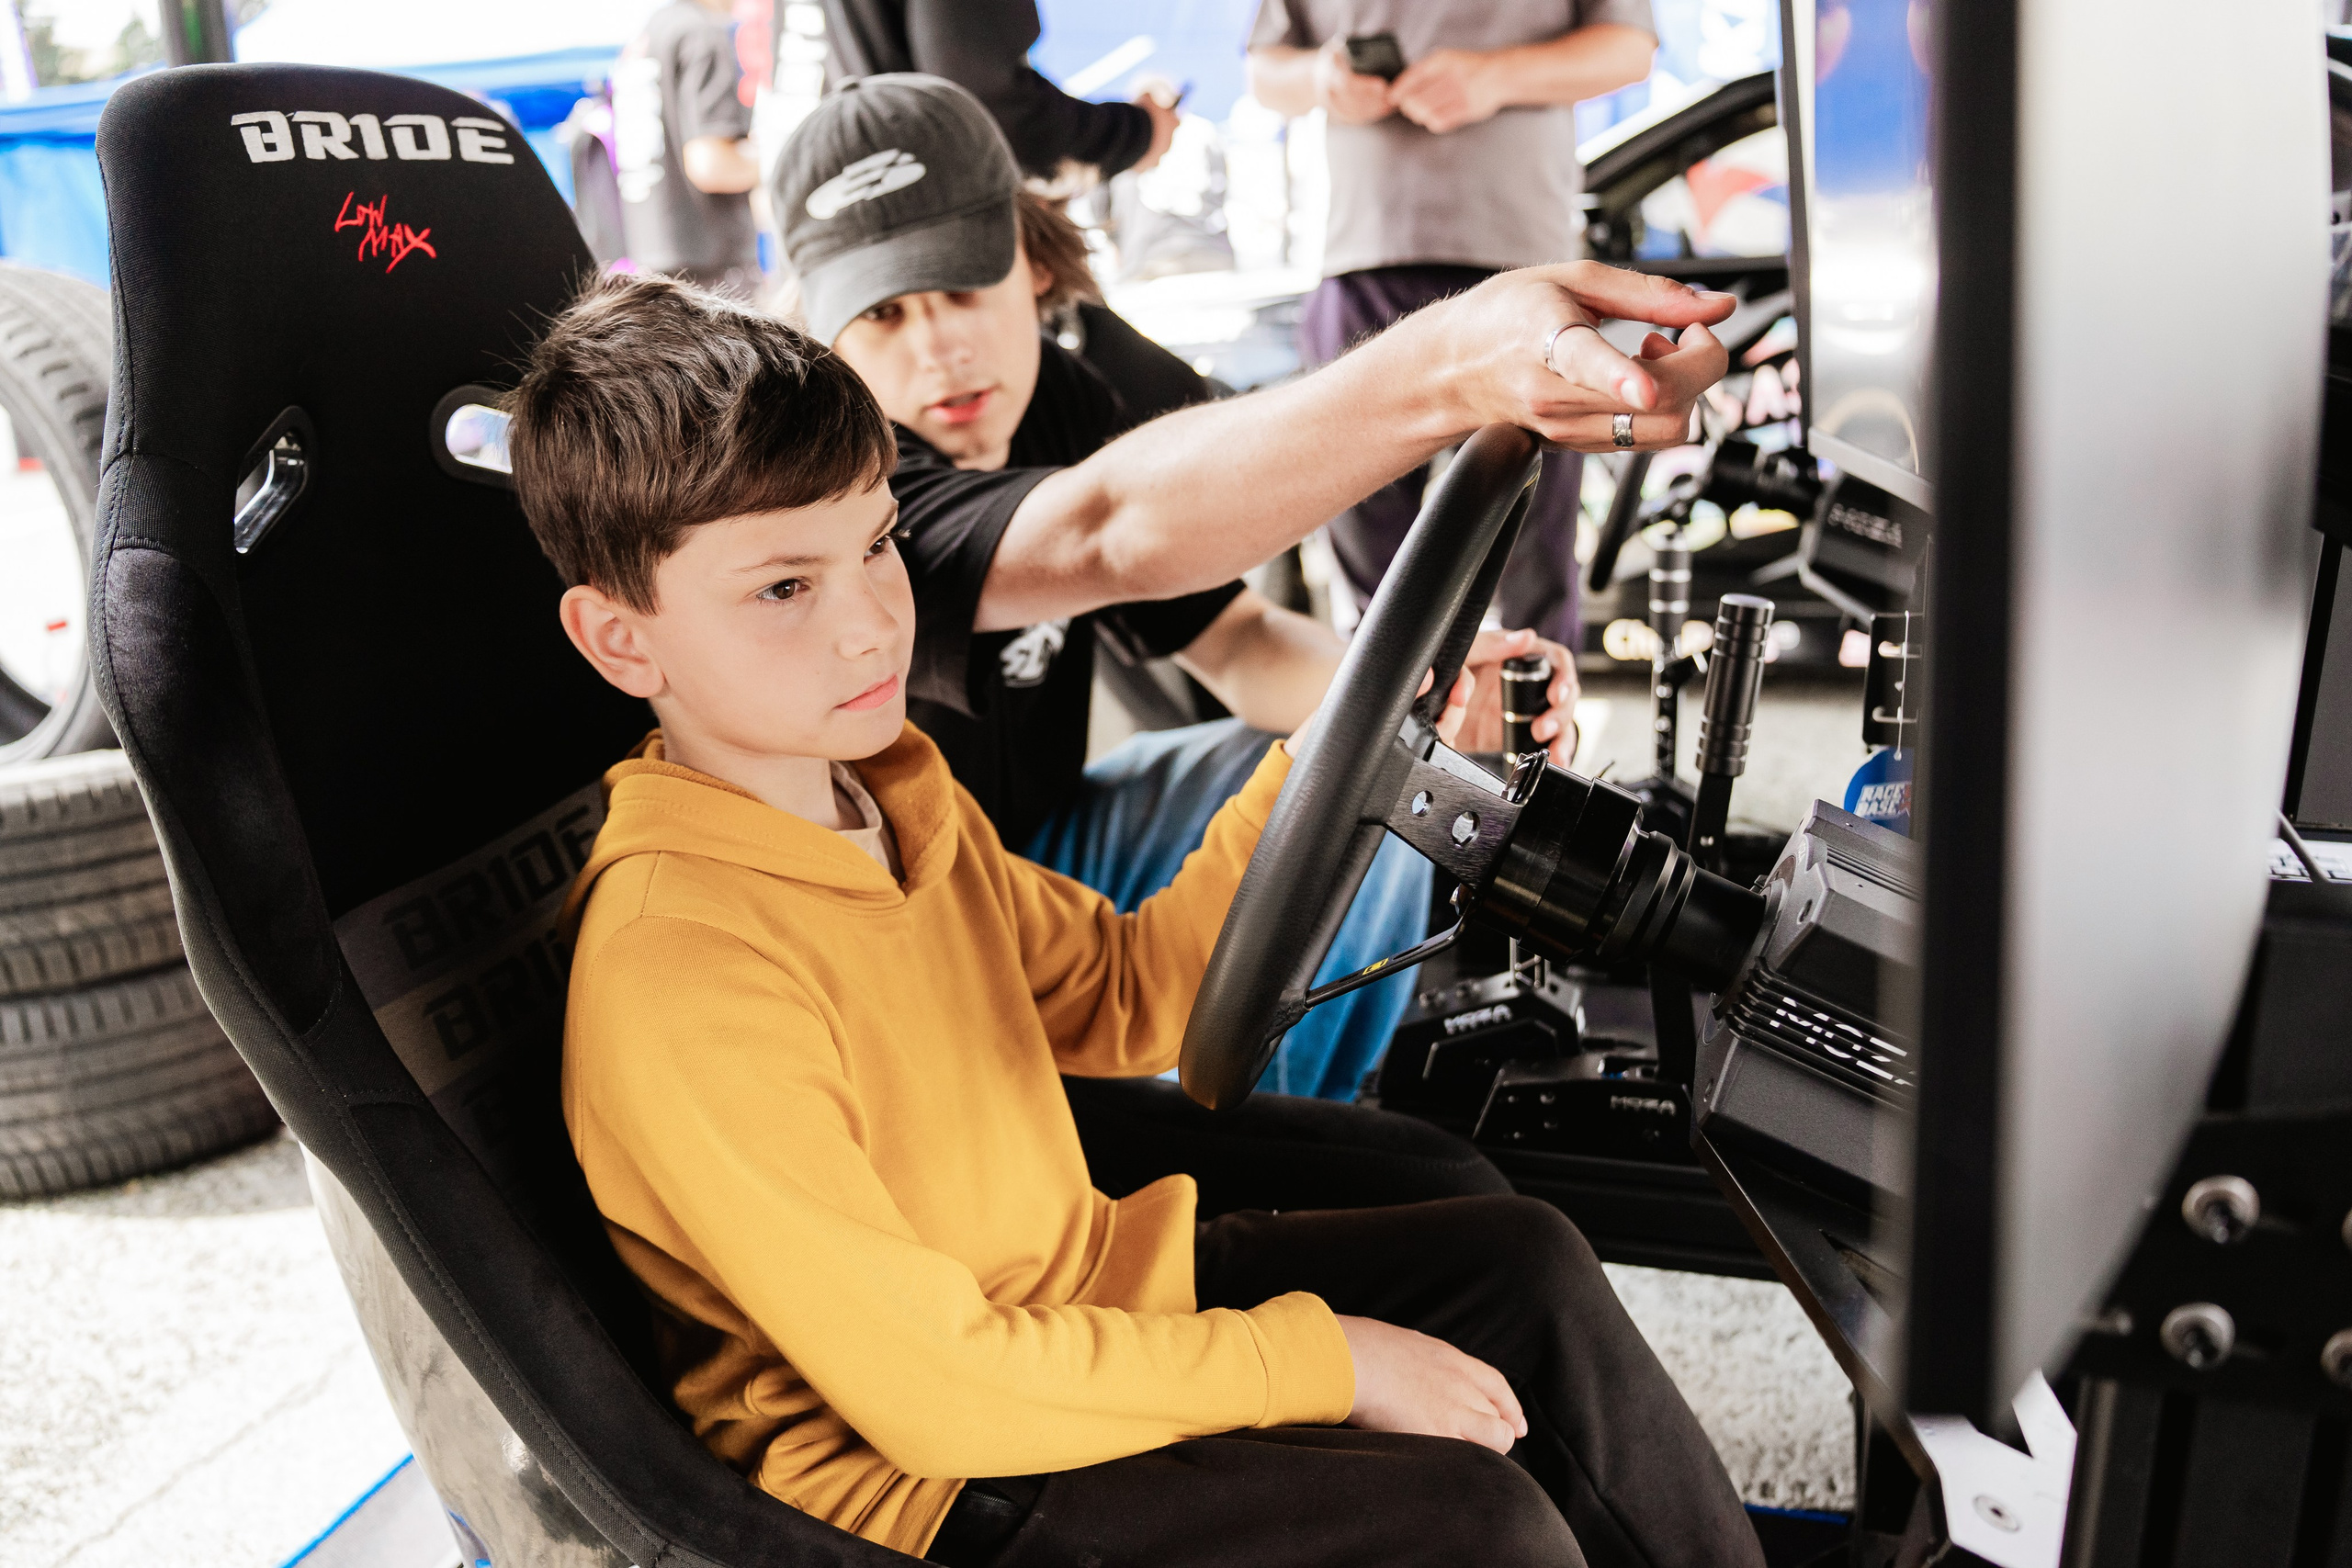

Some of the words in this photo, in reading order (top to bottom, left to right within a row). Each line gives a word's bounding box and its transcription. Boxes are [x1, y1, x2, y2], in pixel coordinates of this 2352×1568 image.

[231, 111, 514, 164] BRIDE
[423, 928, 570, 1062] BRI
[1770, 997, 1917, 1088] MOZ
